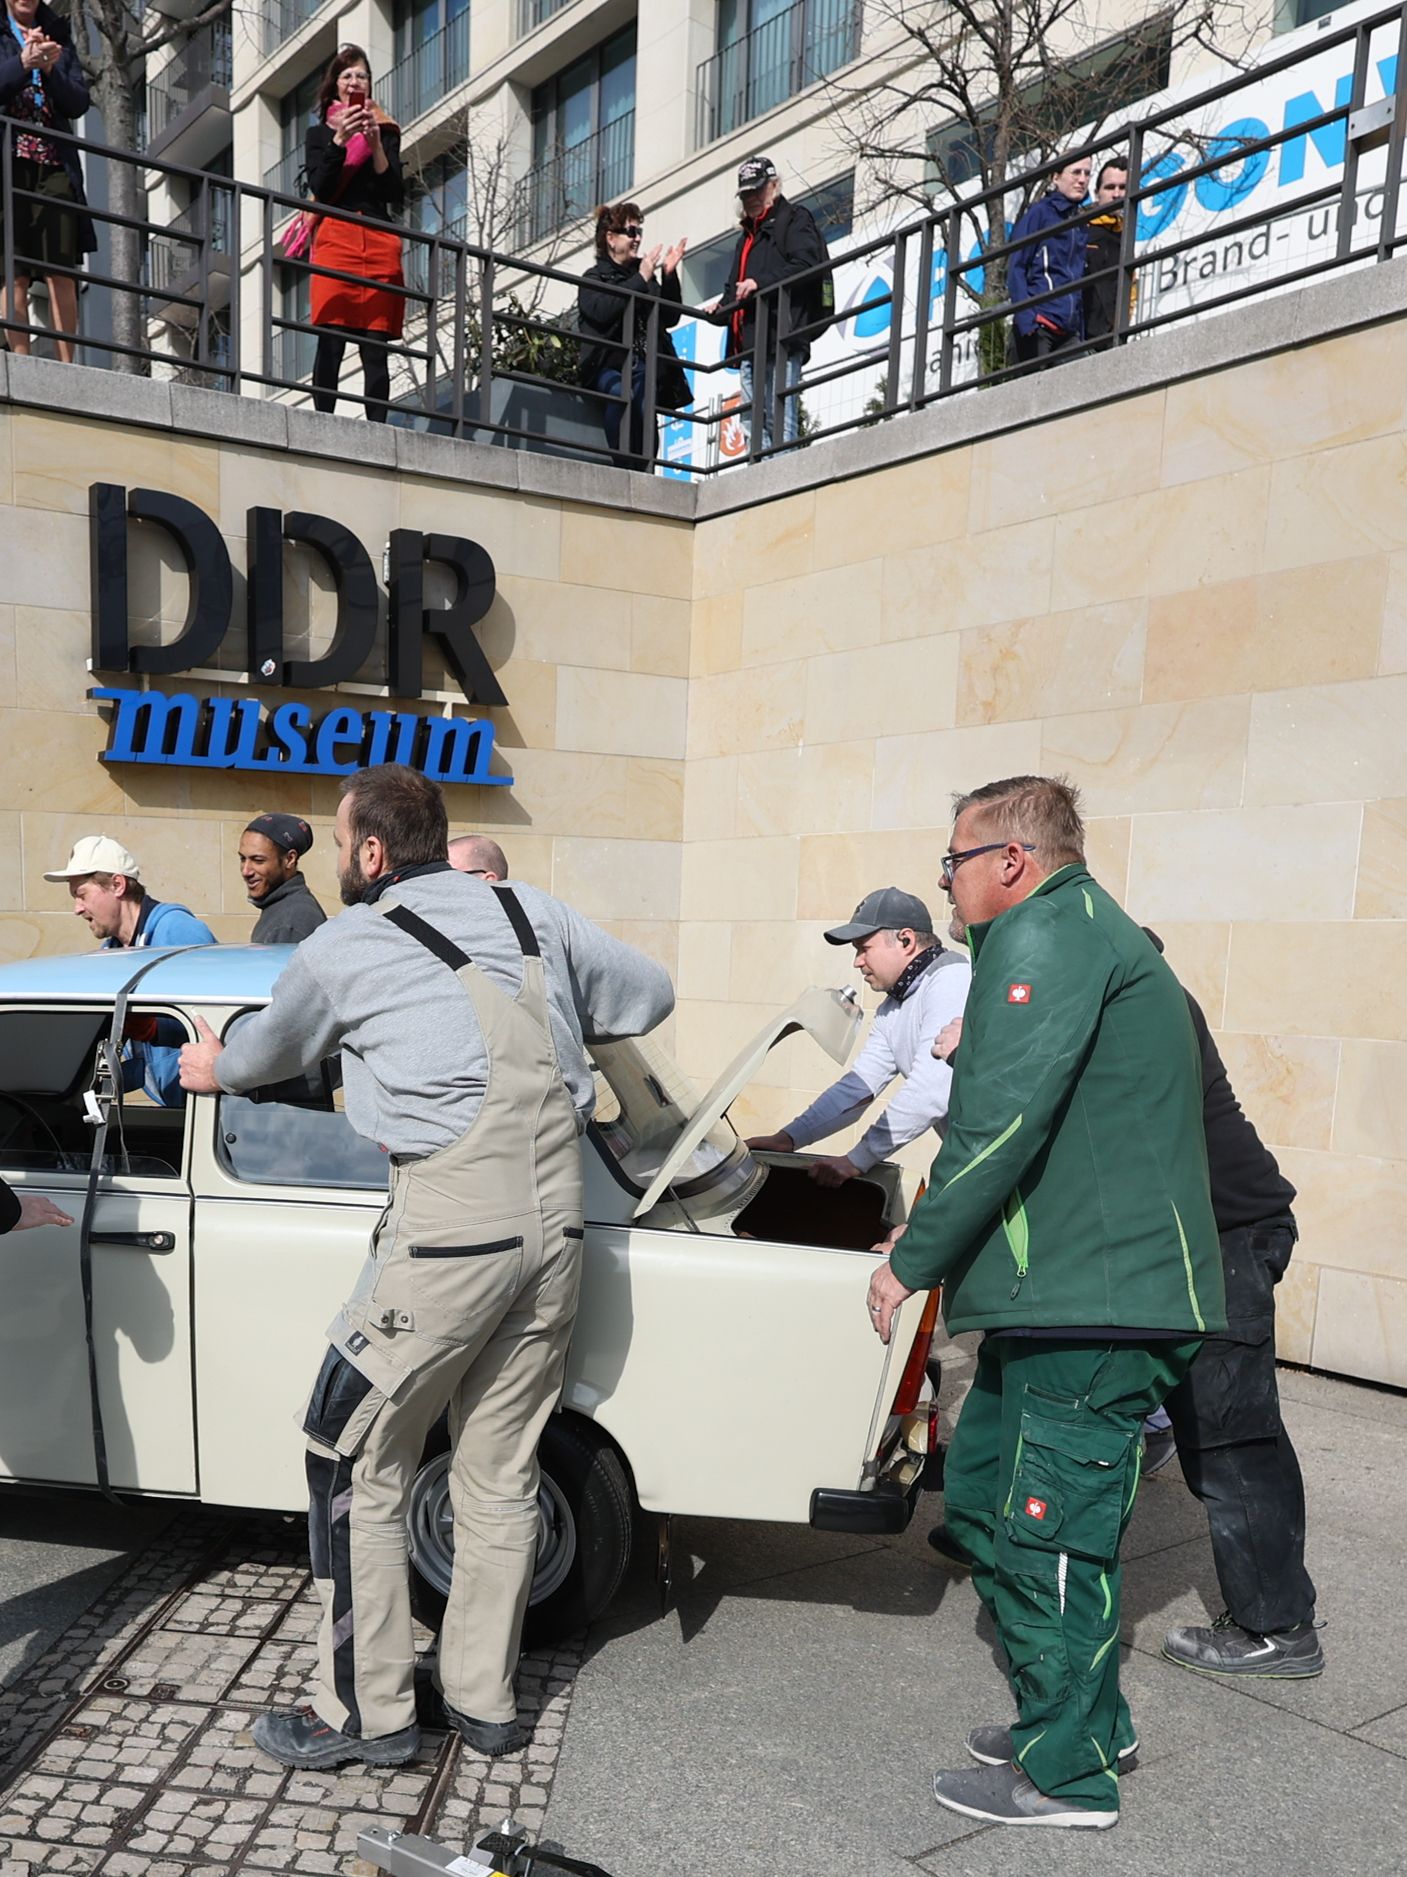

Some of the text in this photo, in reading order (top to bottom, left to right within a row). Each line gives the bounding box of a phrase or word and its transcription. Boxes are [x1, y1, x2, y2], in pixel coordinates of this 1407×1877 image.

[1158, 221, 1291, 294] Brand-
[89, 481, 509, 707] DDR
[90, 686, 514, 786] museum
